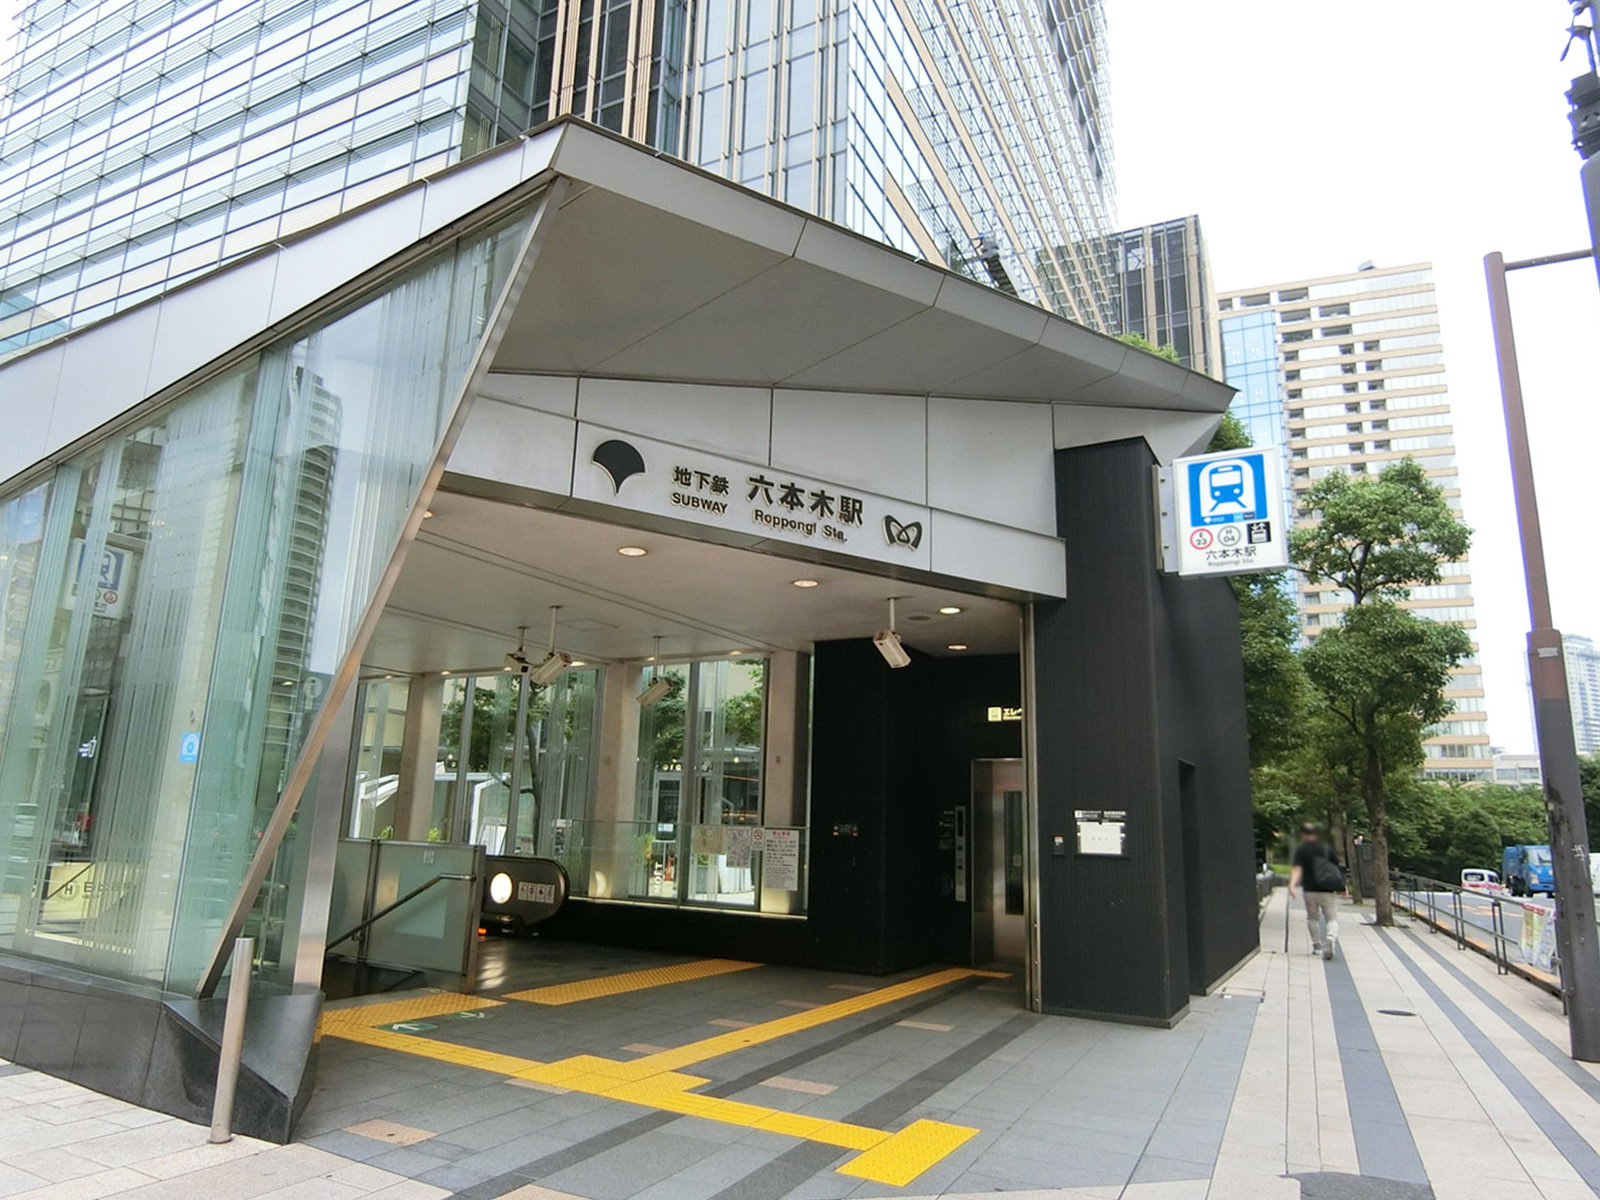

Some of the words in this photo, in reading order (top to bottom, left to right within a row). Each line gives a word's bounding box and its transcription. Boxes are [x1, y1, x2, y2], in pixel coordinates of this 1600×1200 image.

[671, 492, 728, 515] SUBWAY
[754, 509, 817, 536] Roppongi
[823, 525, 848, 543] Sta.
[673, 466, 729, 495] 地下鉄
[746, 475, 864, 526] 六本木駅
[1205, 546, 1256, 560] 六本木駅
